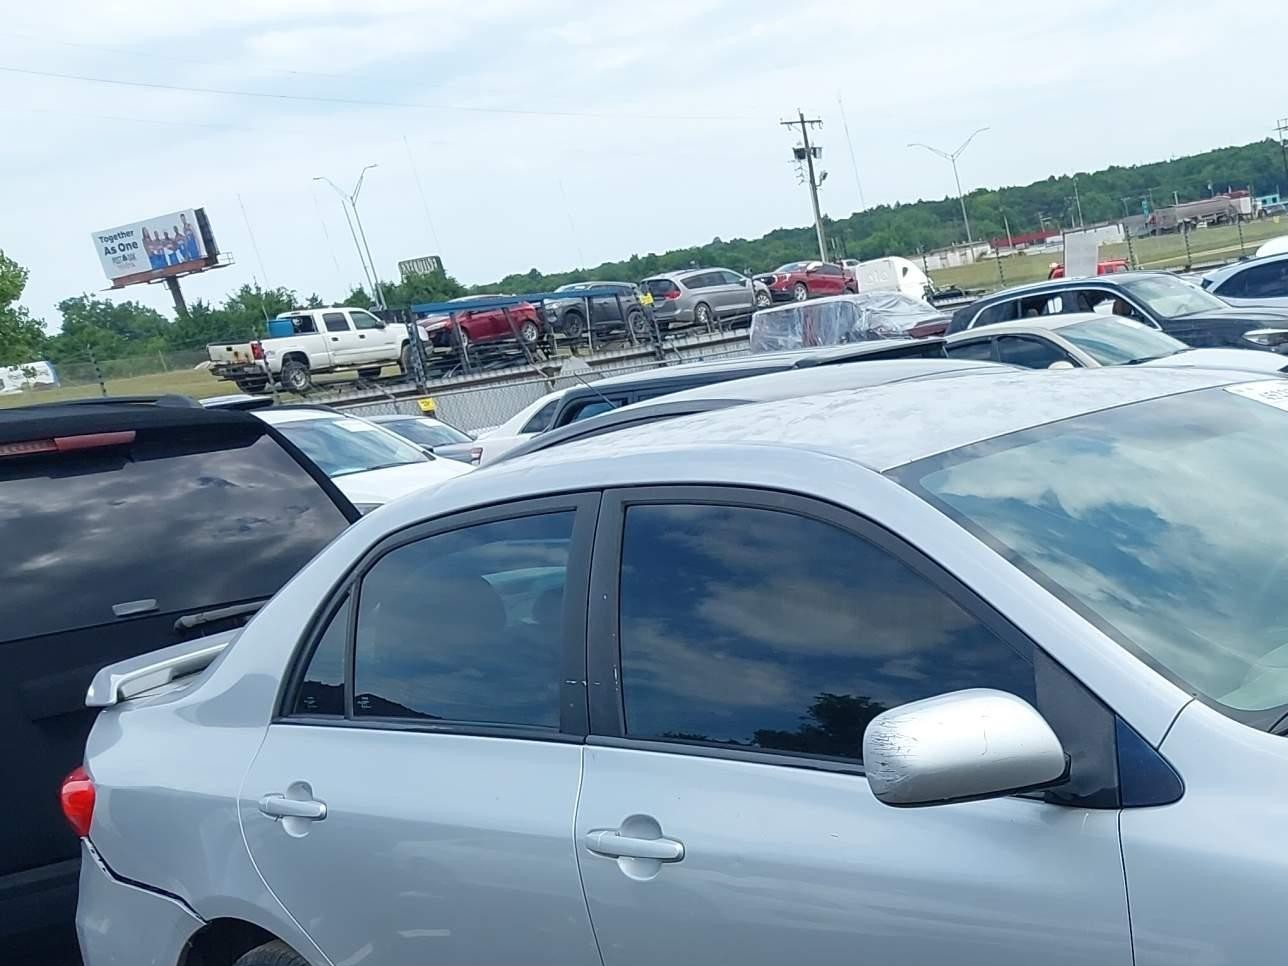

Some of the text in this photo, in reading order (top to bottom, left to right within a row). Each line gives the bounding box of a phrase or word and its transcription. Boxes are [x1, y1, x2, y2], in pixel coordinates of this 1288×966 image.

[98, 230, 134, 243] Together
[104, 241, 138, 256] As One
